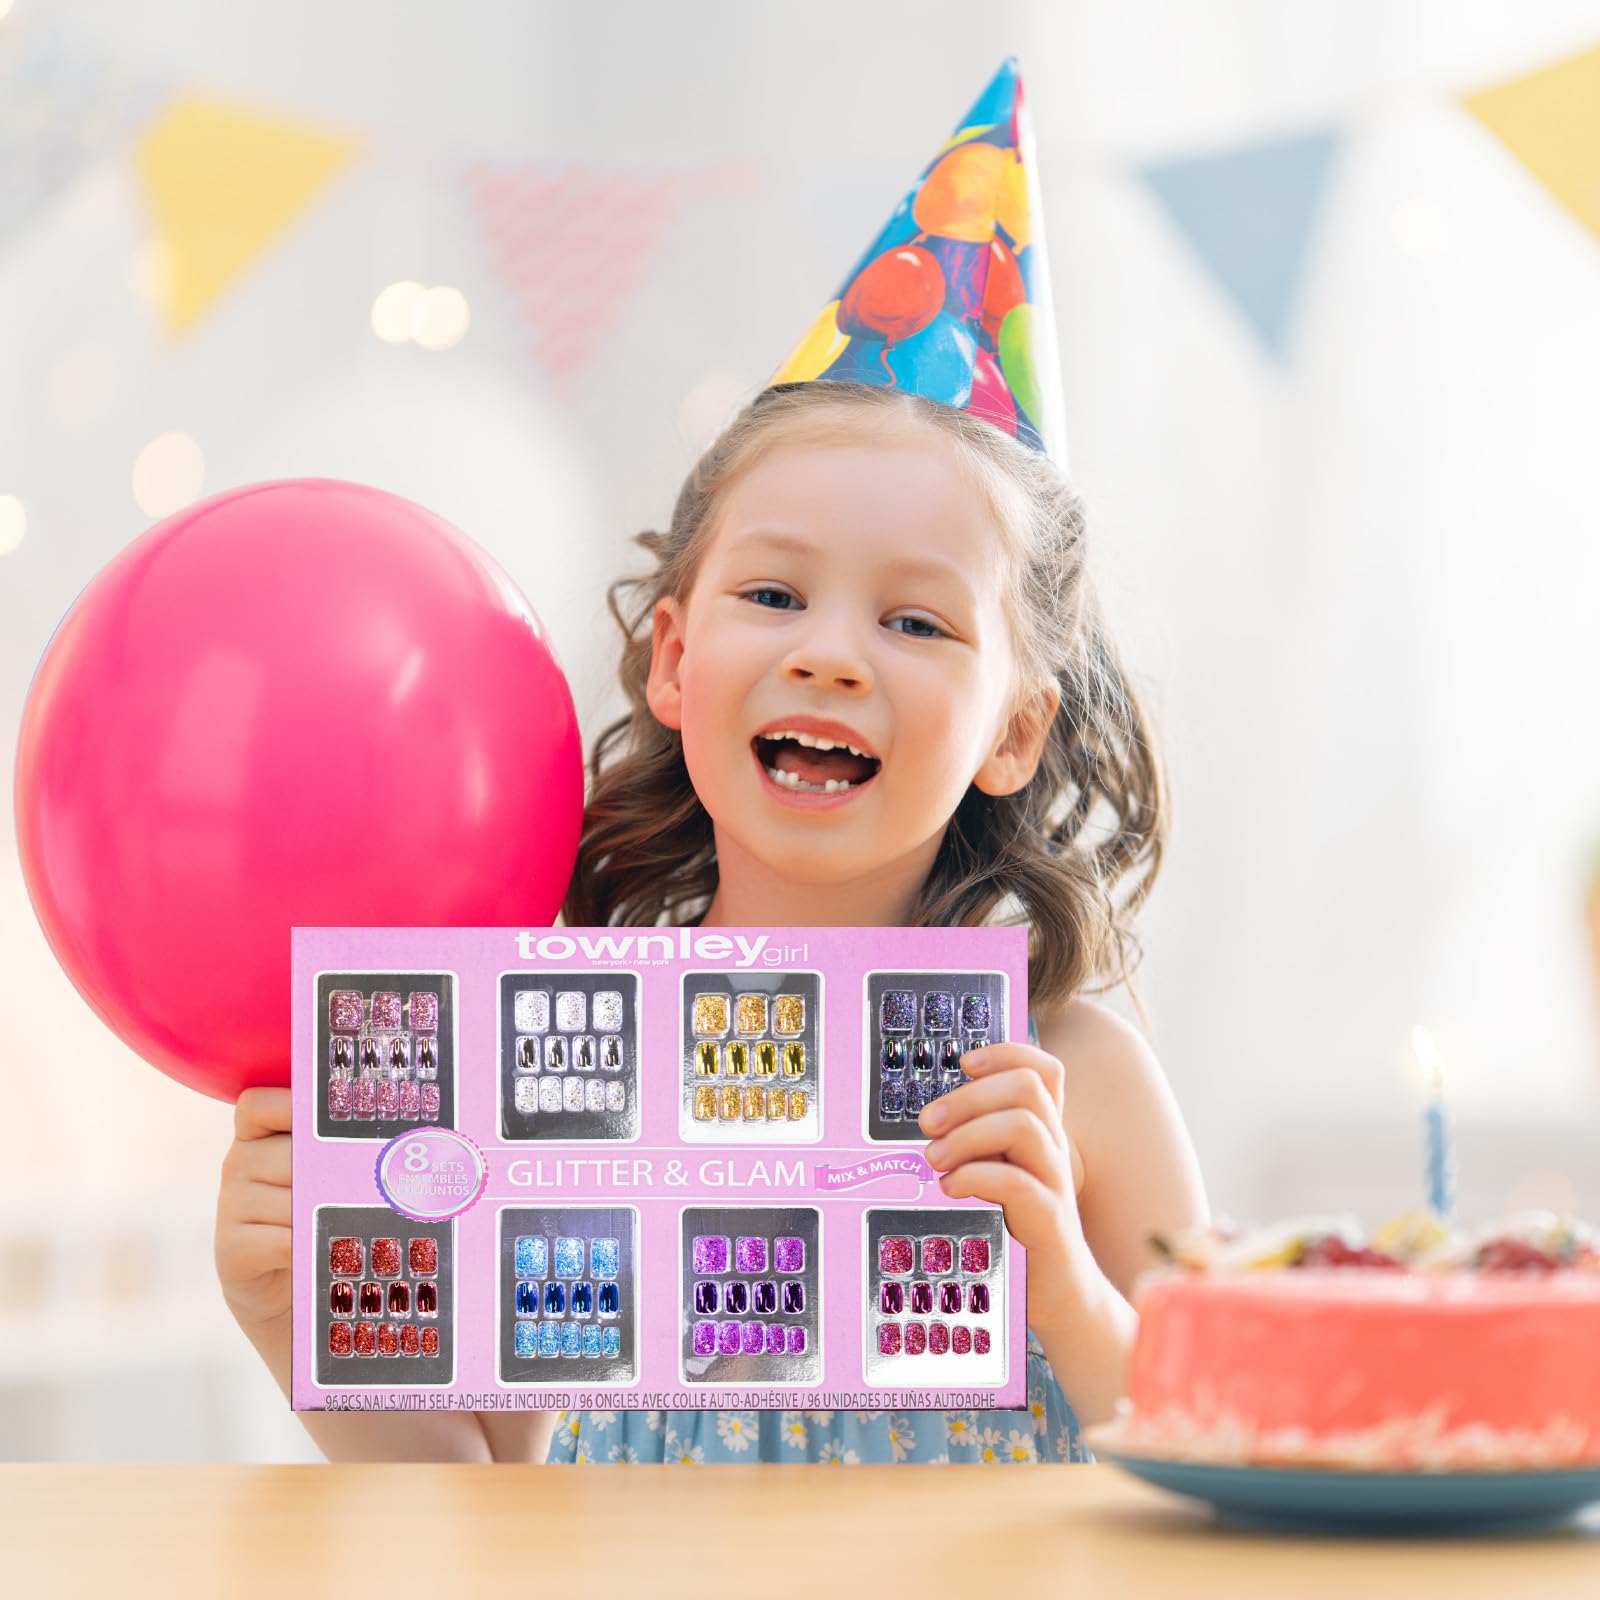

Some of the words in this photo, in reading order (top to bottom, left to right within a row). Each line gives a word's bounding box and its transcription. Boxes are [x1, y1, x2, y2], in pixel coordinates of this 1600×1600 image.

[515, 927, 769, 966] townley
[762, 944, 809, 966] girl
[610, 959, 627, 967] york
[404, 1142, 429, 1172] 8
[431, 1160, 465, 1173] SETS
[399, 1173, 468, 1184] ENMBLES
[507, 1159, 653, 1187] GLITTER
[663, 1159, 689, 1187] &
[698, 1159, 806, 1187] GLAM
[828, 1171, 856, 1183] MIX
[857, 1166, 868, 1176] &
[870, 1160, 922, 1173] MATCH
[325, 1394, 339, 1410] 96
[341, 1394, 362, 1410] PCS
[364, 1394, 396, 1409] NAILS
[399, 1393, 426, 1409] WITH
[429, 1393, 512, 1409] SELF-ADHESIVE
[514, 1393, 570, 1409] INCLUDED
[580, 1393, 593, 1408] 96
[595, 1393, 639, 1408] ONGLES
[642, 1393, 671, 1408] AVEC
[673, 1393, 707, 1408] COLLE
[709, 1390, 798, 1408] AUTO-ADHÉSIVE
[807, 1393, 821, 1408] 96
[823, 1393, 880, 1408] UNIDADES
[883, 1393, 898, 1408] DE
[901, 1390, 932, 1408] UÑAS
[934, 1393, 995, 1408] AUTOADHE
